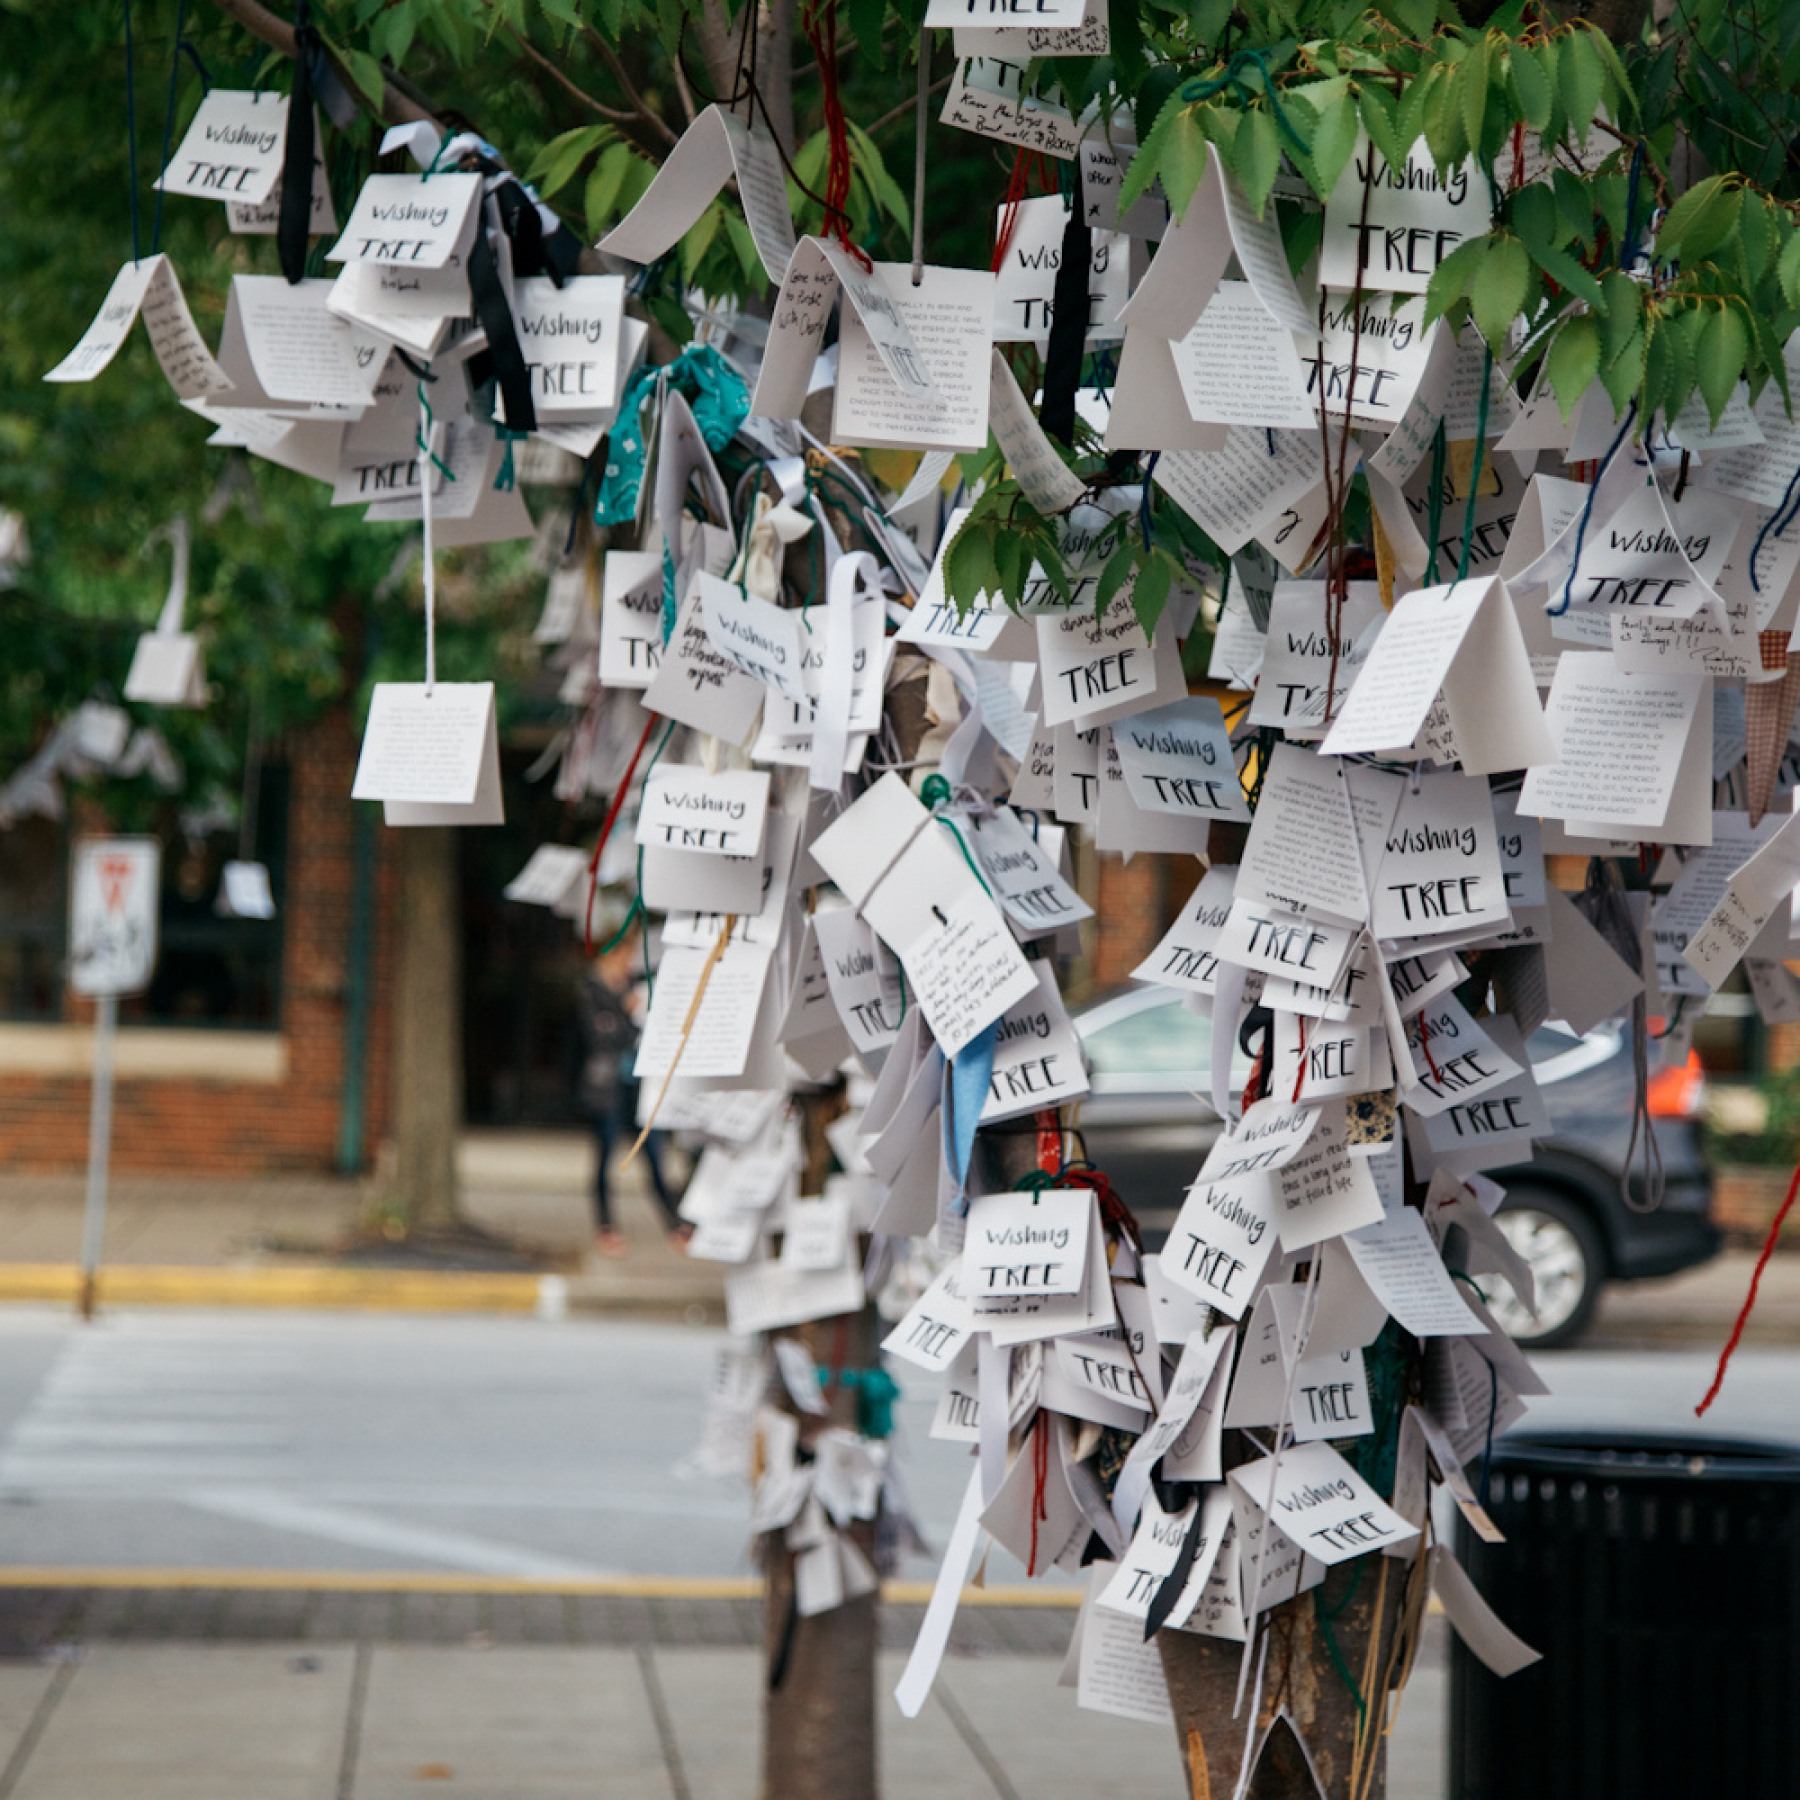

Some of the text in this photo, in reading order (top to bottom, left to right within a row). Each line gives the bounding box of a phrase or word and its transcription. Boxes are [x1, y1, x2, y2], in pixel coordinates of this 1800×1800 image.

[205, 125, 277, 154] Wishing
[187, 161, 260, 192] TREE
[372, 204, 448, 227] Wishing
[357, 239, 435, 260] TREE
[521, 313, 602, 342] Wishing
[1321, 305, 1414, 351] Wishing
[524, 361, 597, 395] TREE
[1301, 357, 1399, 407] TREE
[354, 464, 421, 493] TREE
[1610, 527, 1711, 562] Wishing
[1588, 577, 1690, 607] TREE
[1058, 648, 1138, 704] TREE
[1131, 730, 1216, 766] Wishing
[664, 792, 746, 820] Wishing
[1142, 774, 1231, 811] TREE
[656, 823, 739, 850] TREE
[1385, 823, 1476, 856] Wishing
[1004, 884, 1075, 920] TREE
[1387, 876, 1485, 921] TREE
[1247, 915, 1328, 970] TREE
[996, 1011, 1051, 1042] shing
[1417, 1049, 1499, 1099] TREE
[1243, 1109, 1309, 1143] Wishing
[1447, 1095, 1531, 1137] TREE
[1206, 1185, 1267, 1245] Wishing
[986, 1225, 1069, 1249] Wishing
[979, 1262, 1065, 1288] TREE
[1183, 1231, 1247, 1299] TREE
[907, 1313, 960, 1360] TREE
[1072, 1352, 1147, 1400] TREE
[1300, 1381, 1359, 1425] TREE
[1277, 1478, 1356, 1514] Wishing
[1309, 1511, 1396, 1551] TREE
